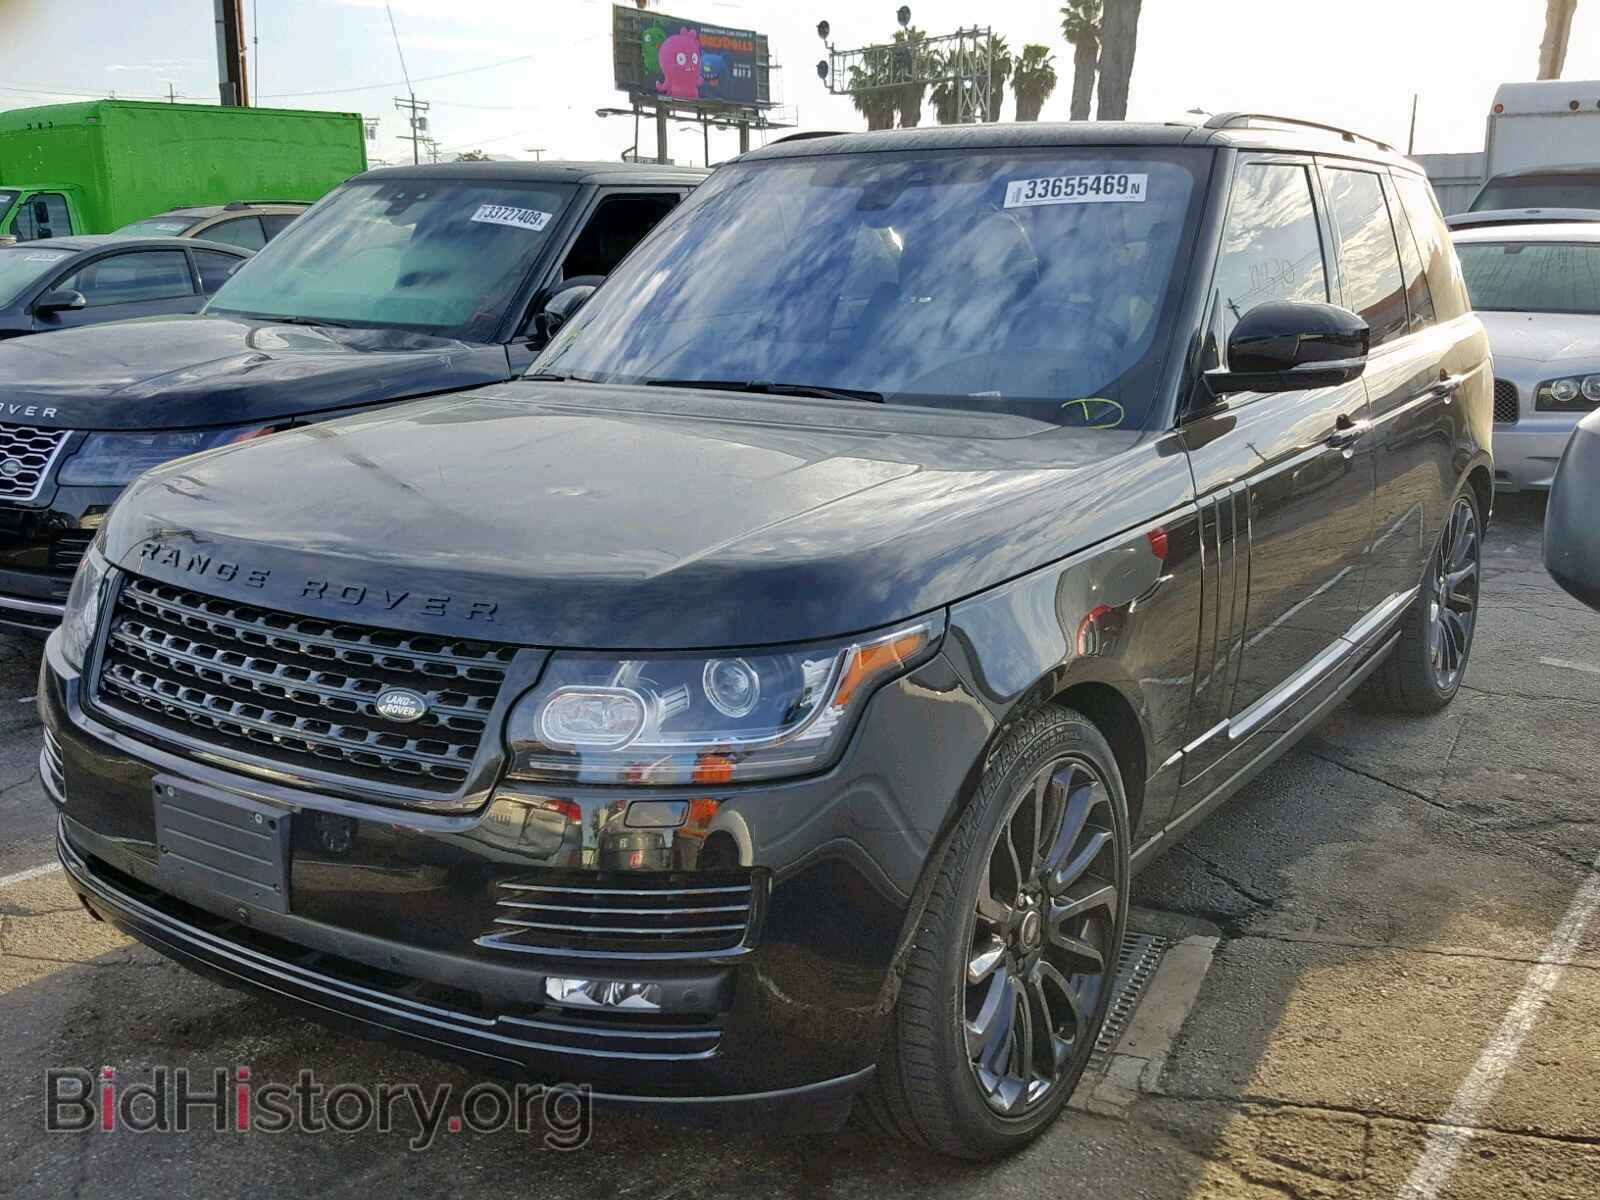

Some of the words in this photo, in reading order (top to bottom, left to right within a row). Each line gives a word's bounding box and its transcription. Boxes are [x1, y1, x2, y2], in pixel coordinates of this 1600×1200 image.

[1024, 174, 1129, 200] 33655469
[140, 543, 271, 589] RANGE
[301, 579, 498, 622] ROVER
[386, 703, 416, 717] ROVER
